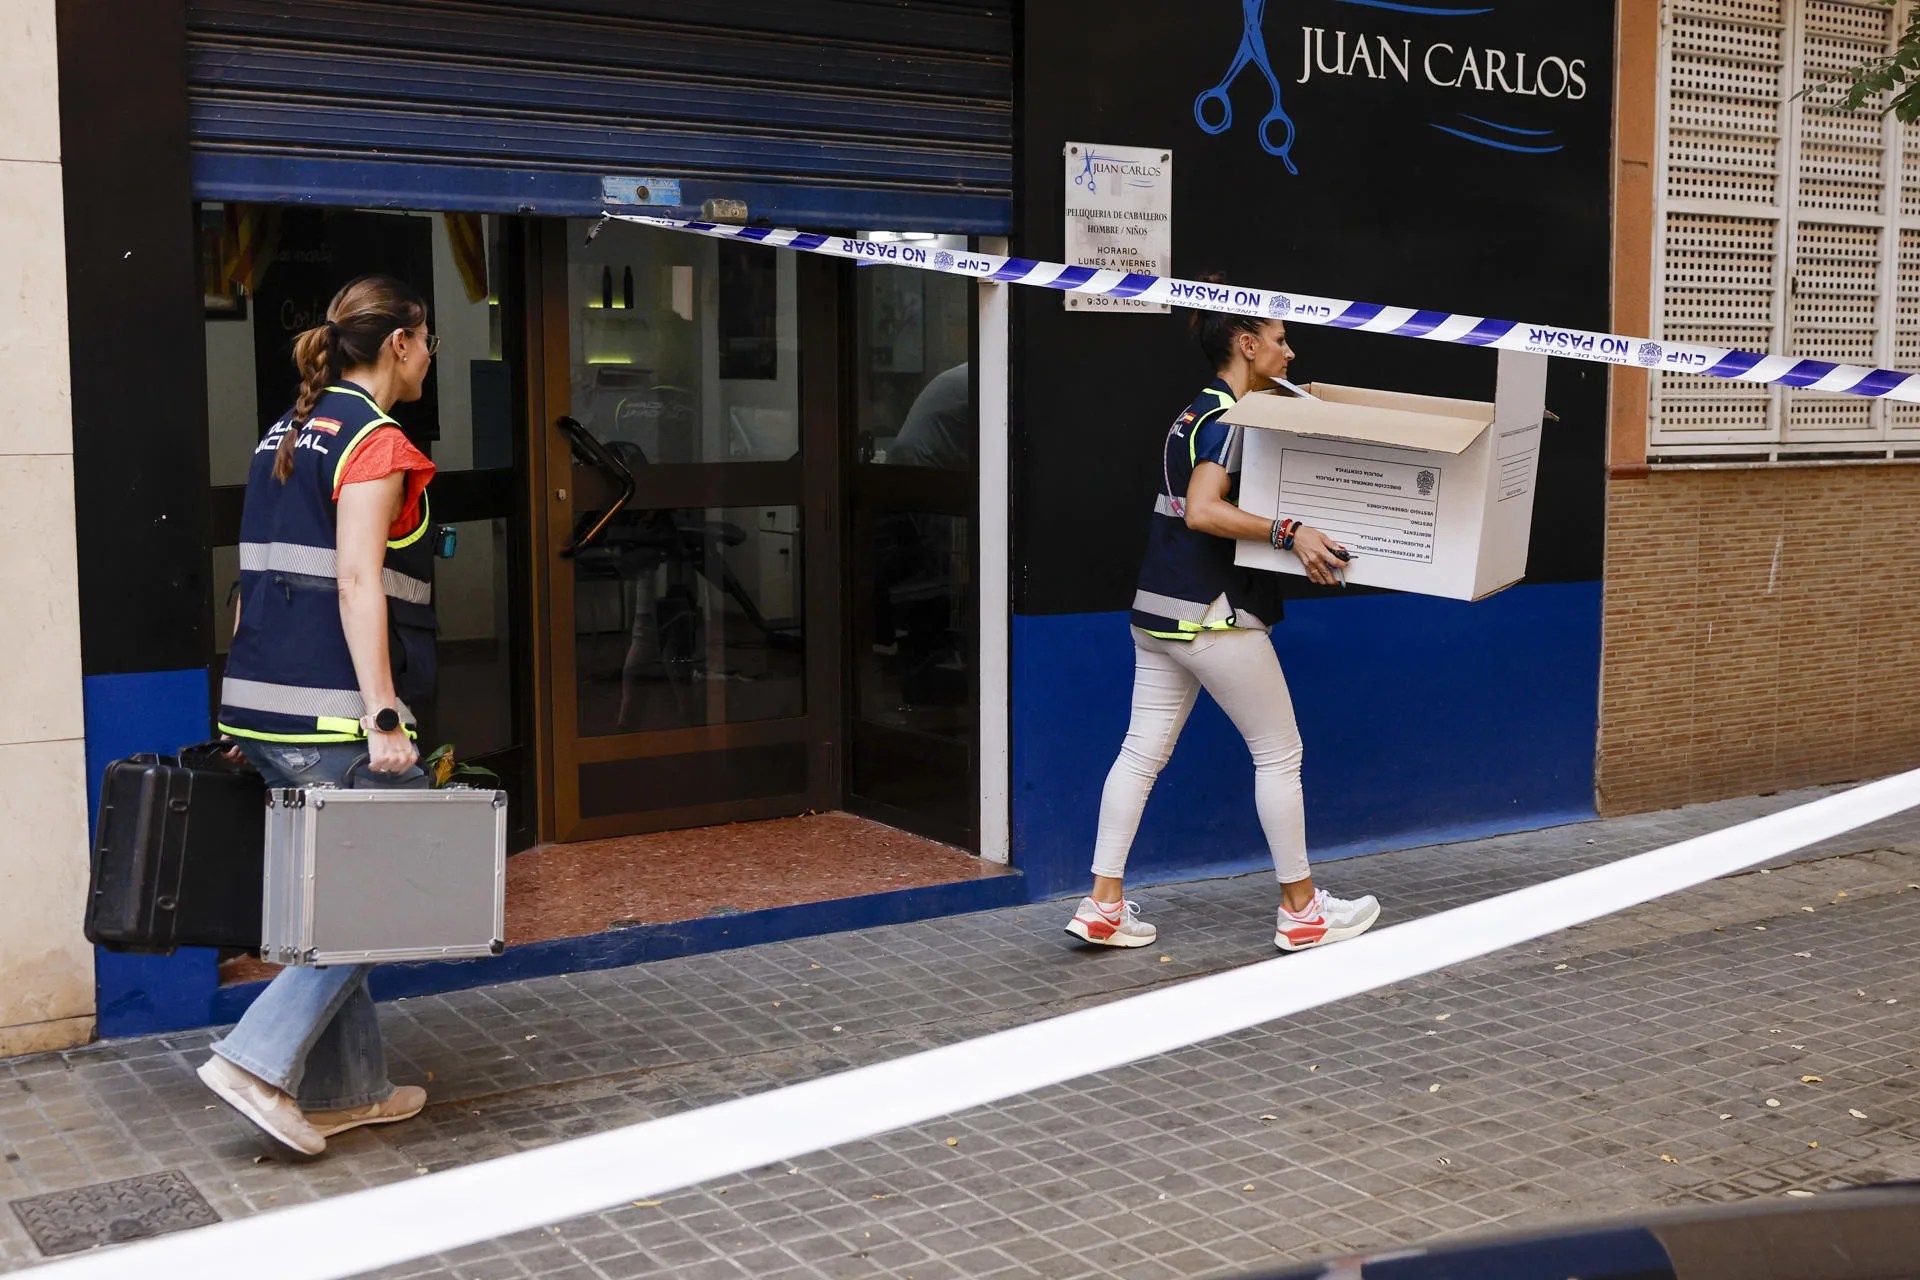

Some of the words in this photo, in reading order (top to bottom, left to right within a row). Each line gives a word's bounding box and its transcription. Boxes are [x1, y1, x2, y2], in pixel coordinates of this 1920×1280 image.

[1297, 26, 1411, 84] JUAN
[1424, 43, 1586, 100] CARLOS
[1093, 163, 1119, 175] JUAN
[1121, 165, 1161, 177] CARLOS
[1113, 211, 1123, 219] DE
[1124, 211, 1168, 221] CABALLEROS
[1087, 225, 1119, 234] HOMBRE
[1126, 225, 1148, 236] NIÑOS
[842, 239, 897, 259] PASAR
[903, 247, 926, 263] NO
[1097, 246, 1138, 255] HORARIO
[957, 258, 990, 272] CNP
[1078, 257, 1108, 266] LUNES
[1120, 259, 1157, 268] VIERNES
[1170, 282, 1229, 303] PASAR
[1087, 297, 1109, 307] 9:30
[1234, 291, 1261, 308] NO
[1294, 304, 1331, 317] CNP
[1529, 328, 1594, 351] PASAR
[1600, 338, 1629, 356] NO
[1574, 352, 1590, 360] DE
[1666, 352, 1706, 366] CNP
[1351, 479, 1374, 487] GENERAL
[1410, 509, 1434, 517] VESTIGIO
[1392, 539, 1424, 548] DILIGENCIAS
